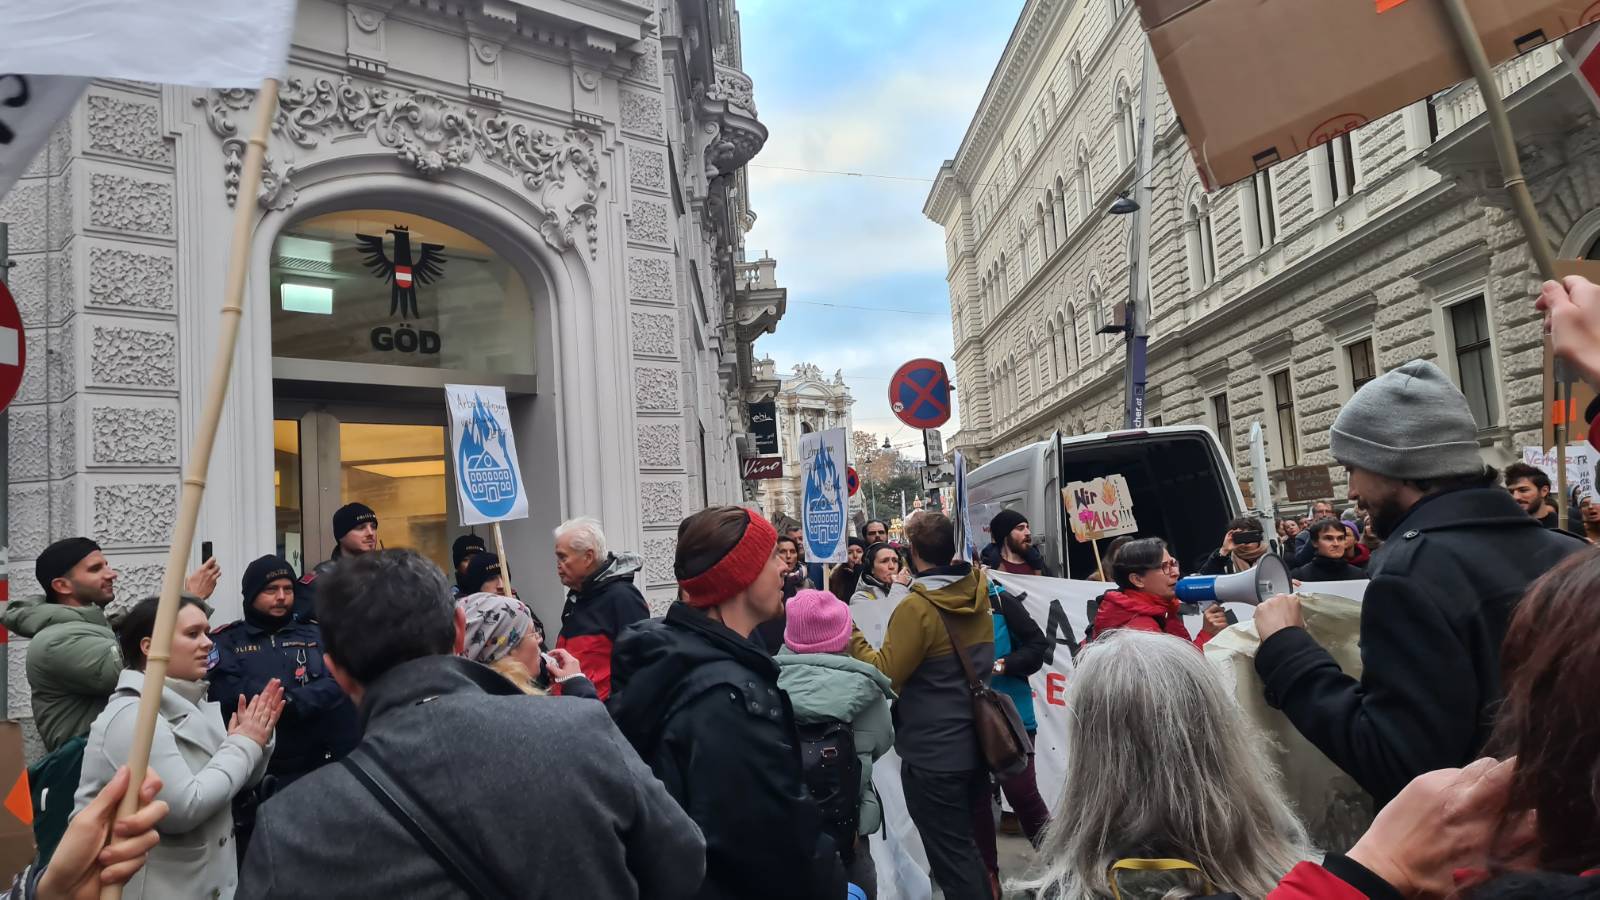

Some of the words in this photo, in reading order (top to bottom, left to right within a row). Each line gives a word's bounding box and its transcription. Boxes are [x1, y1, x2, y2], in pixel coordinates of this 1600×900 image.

[370, 322, 441, 354] GÖD
[744, 460, 780, 478] Vino
[1074, 488, 1098, 510] Wir
